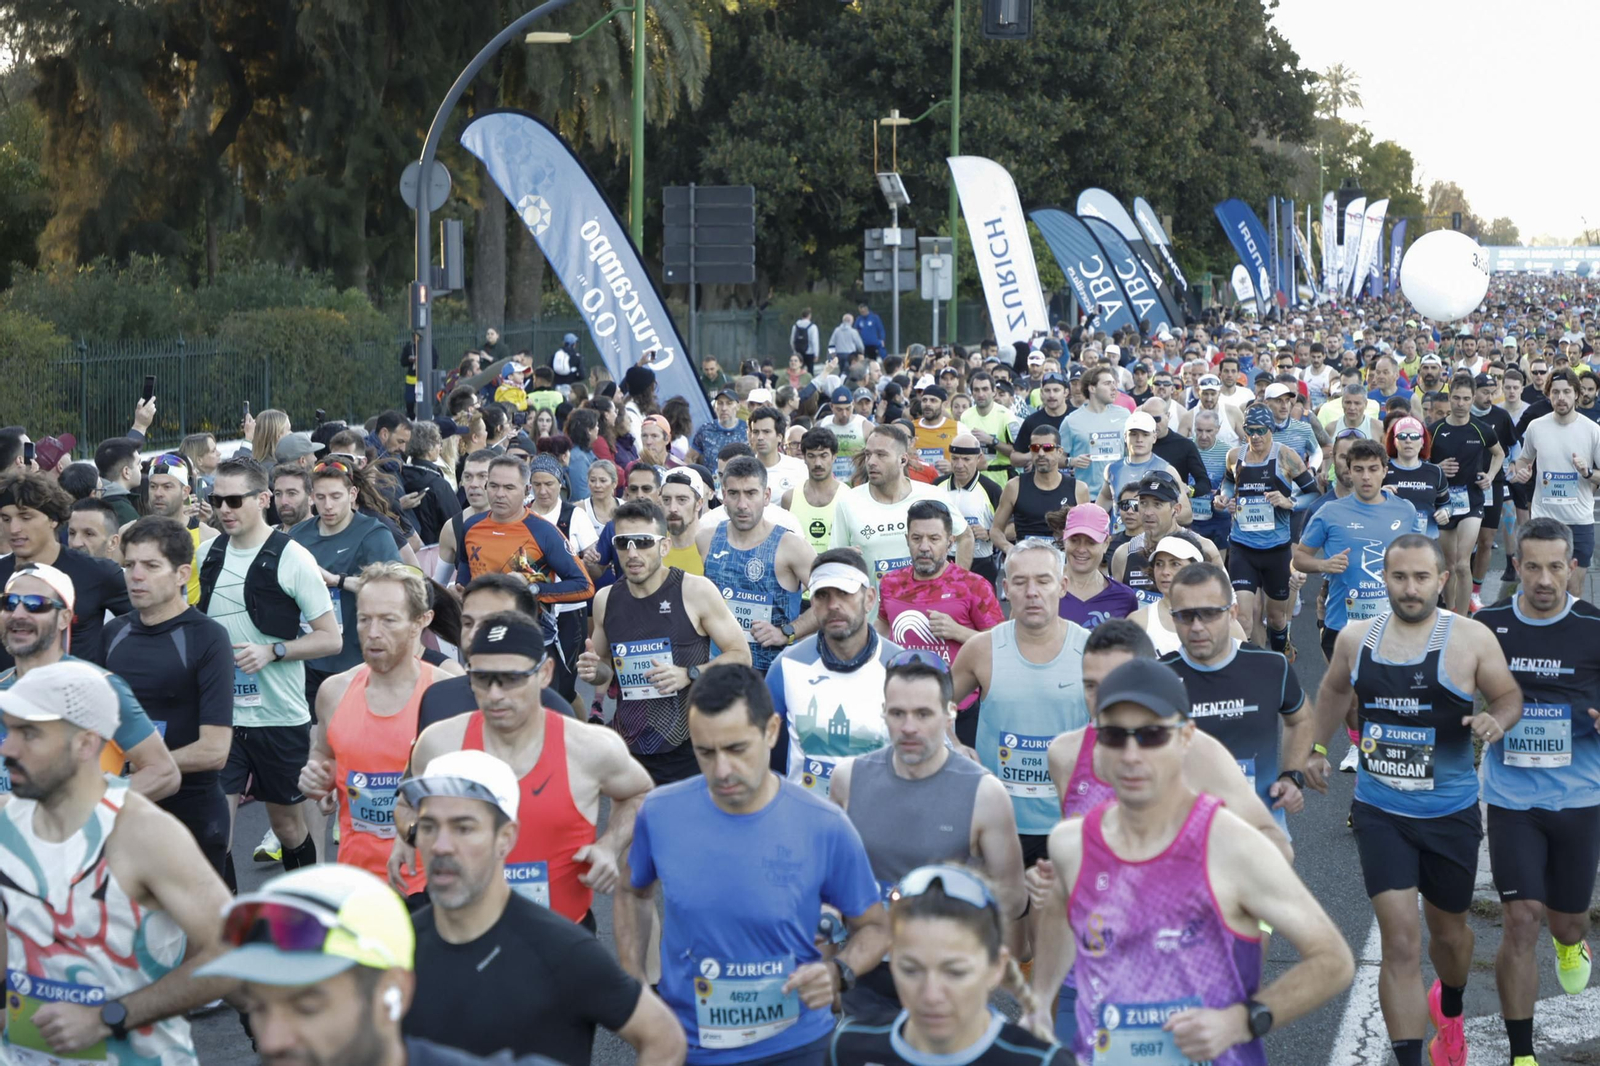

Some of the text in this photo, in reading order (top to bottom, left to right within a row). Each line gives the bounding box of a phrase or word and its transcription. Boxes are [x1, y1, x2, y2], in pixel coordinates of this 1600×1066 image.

[736, 591, 766, 602] ZURICH
[1361, 590, 1386, 598] ZURICH
[735, 606, 751, 615] 5100
[630, 642, 663, 653] ZURICH
[633, 661, 651, 670] 7193
[1510, 657, 1561, 677] MENTON
[1192, 699, 1245, 718] MENTON
[1375, 697, 1420, 714] MENTON
[1524, 708, 1562, 717] ZURICH
[1386, 729, 1426, 741] ZURICH
[1524, 726, 1545, 735] 6129
[1509, 737, 1563, 752] MATHIEU
[1386, 748, 1406, 760] 3811
[1021, 757, 1042, 766] 6784
[1367, 759, 1426, 778] MORGAN
[371, 797, 395, 806] 5297
[726, 961, 783, 977] ZURICH
[36, 983, 92, 1004] ZURICH
[730, 991, 759, 1003] 4627
[710, 1004, 784, 1026] HICHAM
[1130, 1042, 1164, 1057] 5697
